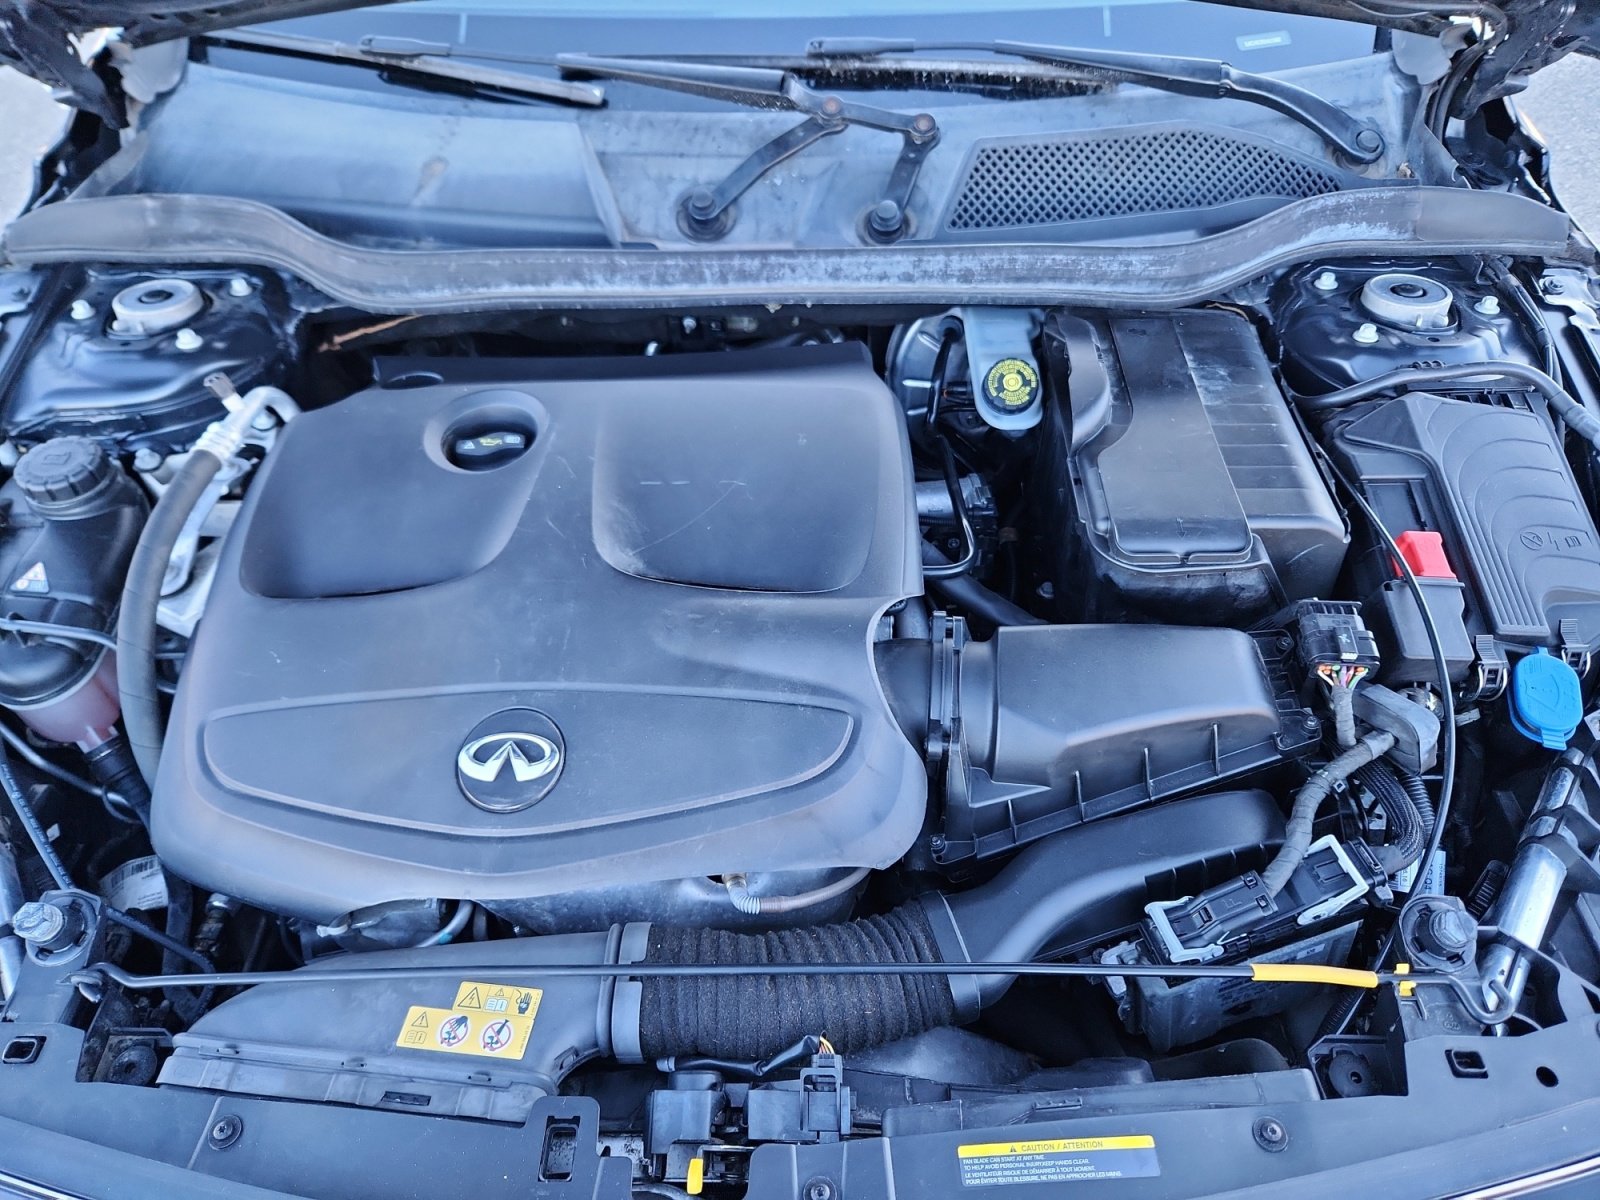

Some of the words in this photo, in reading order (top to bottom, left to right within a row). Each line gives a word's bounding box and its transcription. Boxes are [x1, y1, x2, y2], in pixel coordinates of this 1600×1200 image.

[1021, 1143, 1055, 1152] CAUTION
[1063, 1140, 1103, 1150] ATTENTION
[972, 1170, 1002, 1178] VENTILATEUR
[1066, 1171, 1096, 1179] APPROCHER
